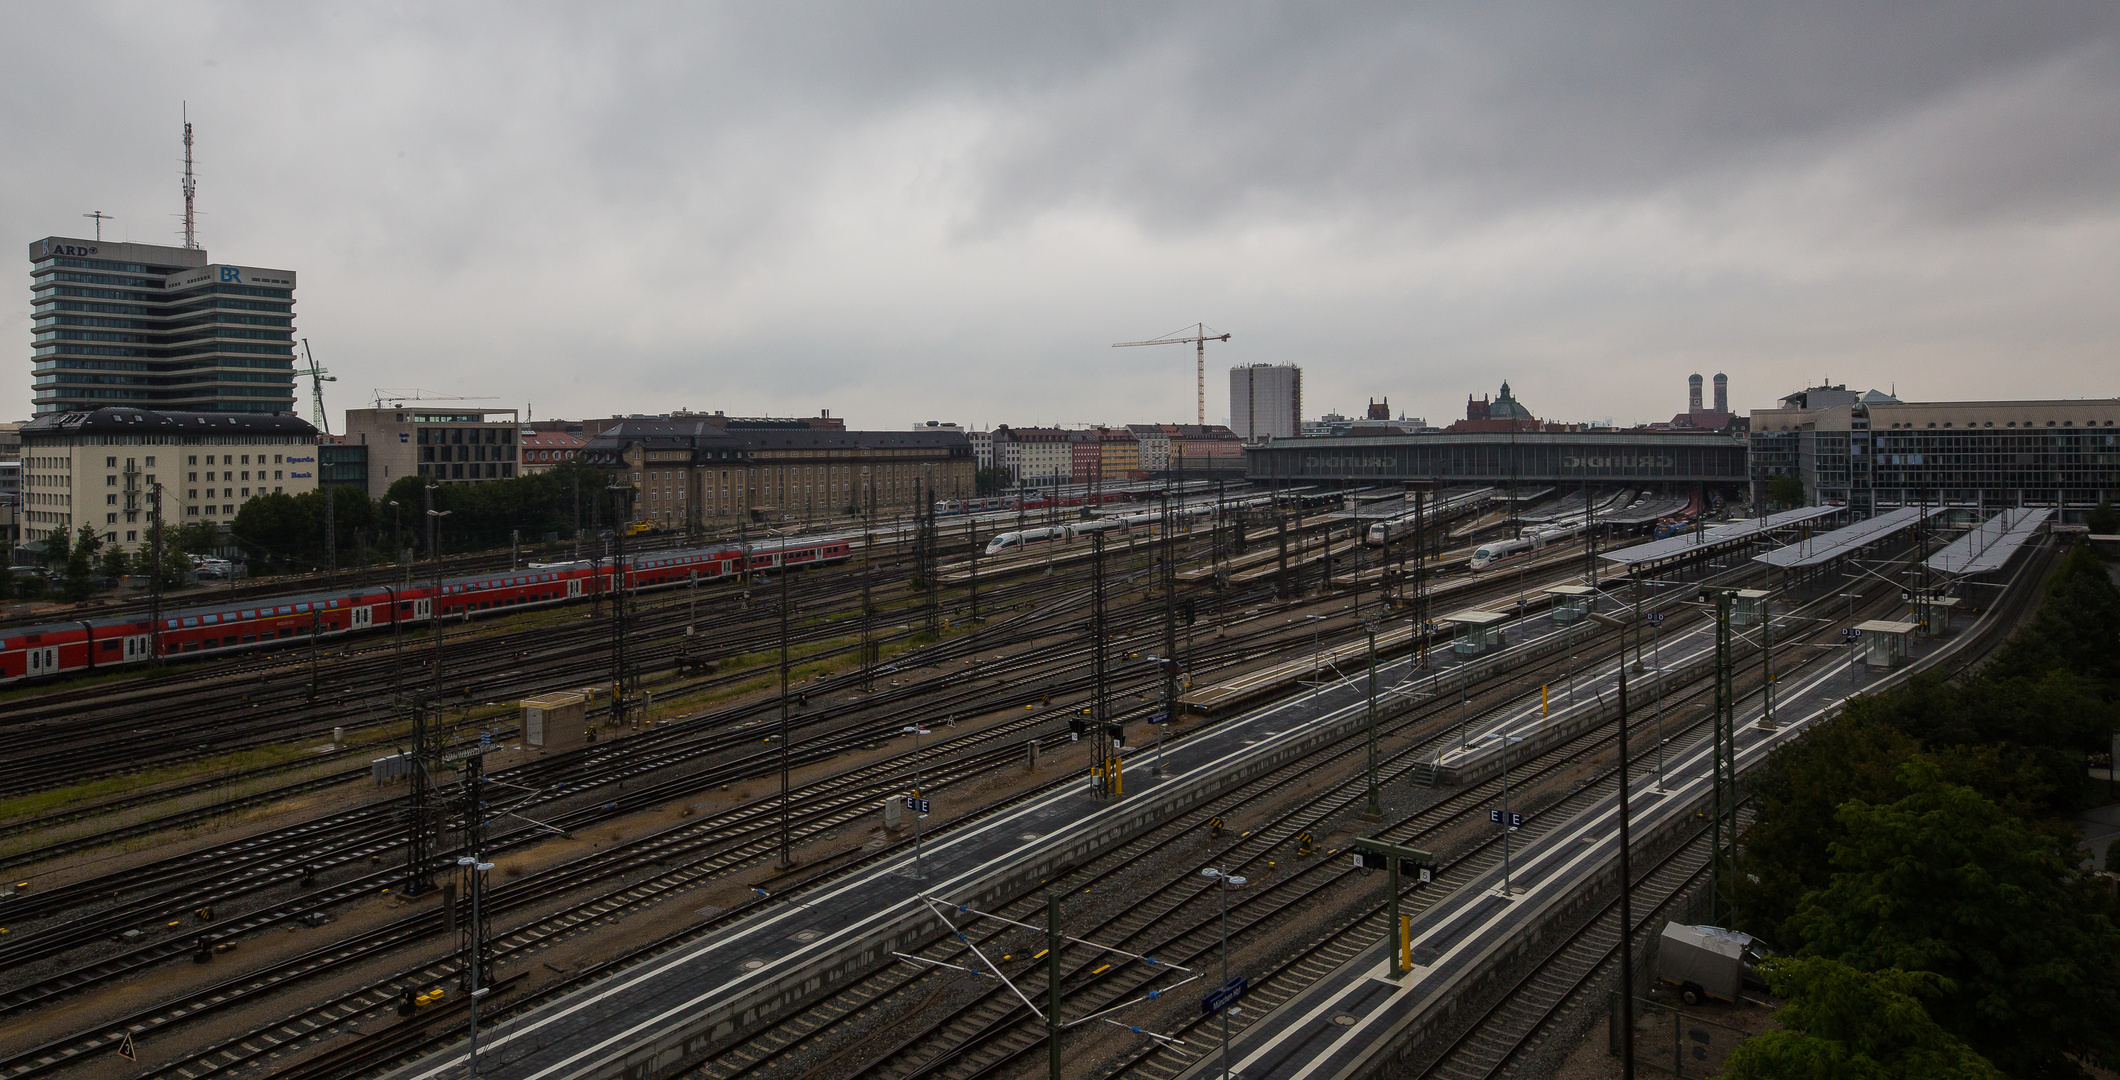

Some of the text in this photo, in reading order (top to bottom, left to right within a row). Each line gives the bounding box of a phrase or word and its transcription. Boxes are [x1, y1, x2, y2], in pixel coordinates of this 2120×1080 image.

[53, 244, 88, 256] ARD
[221, 266, 242, 283] BR
[286, 456, 315, 464] Sparda
[908, 797, 912, 808] E
[922, 801, 927, 811] E
[1491, 810, 1498, 821] E
[1513, 814, 1520, 825] E
